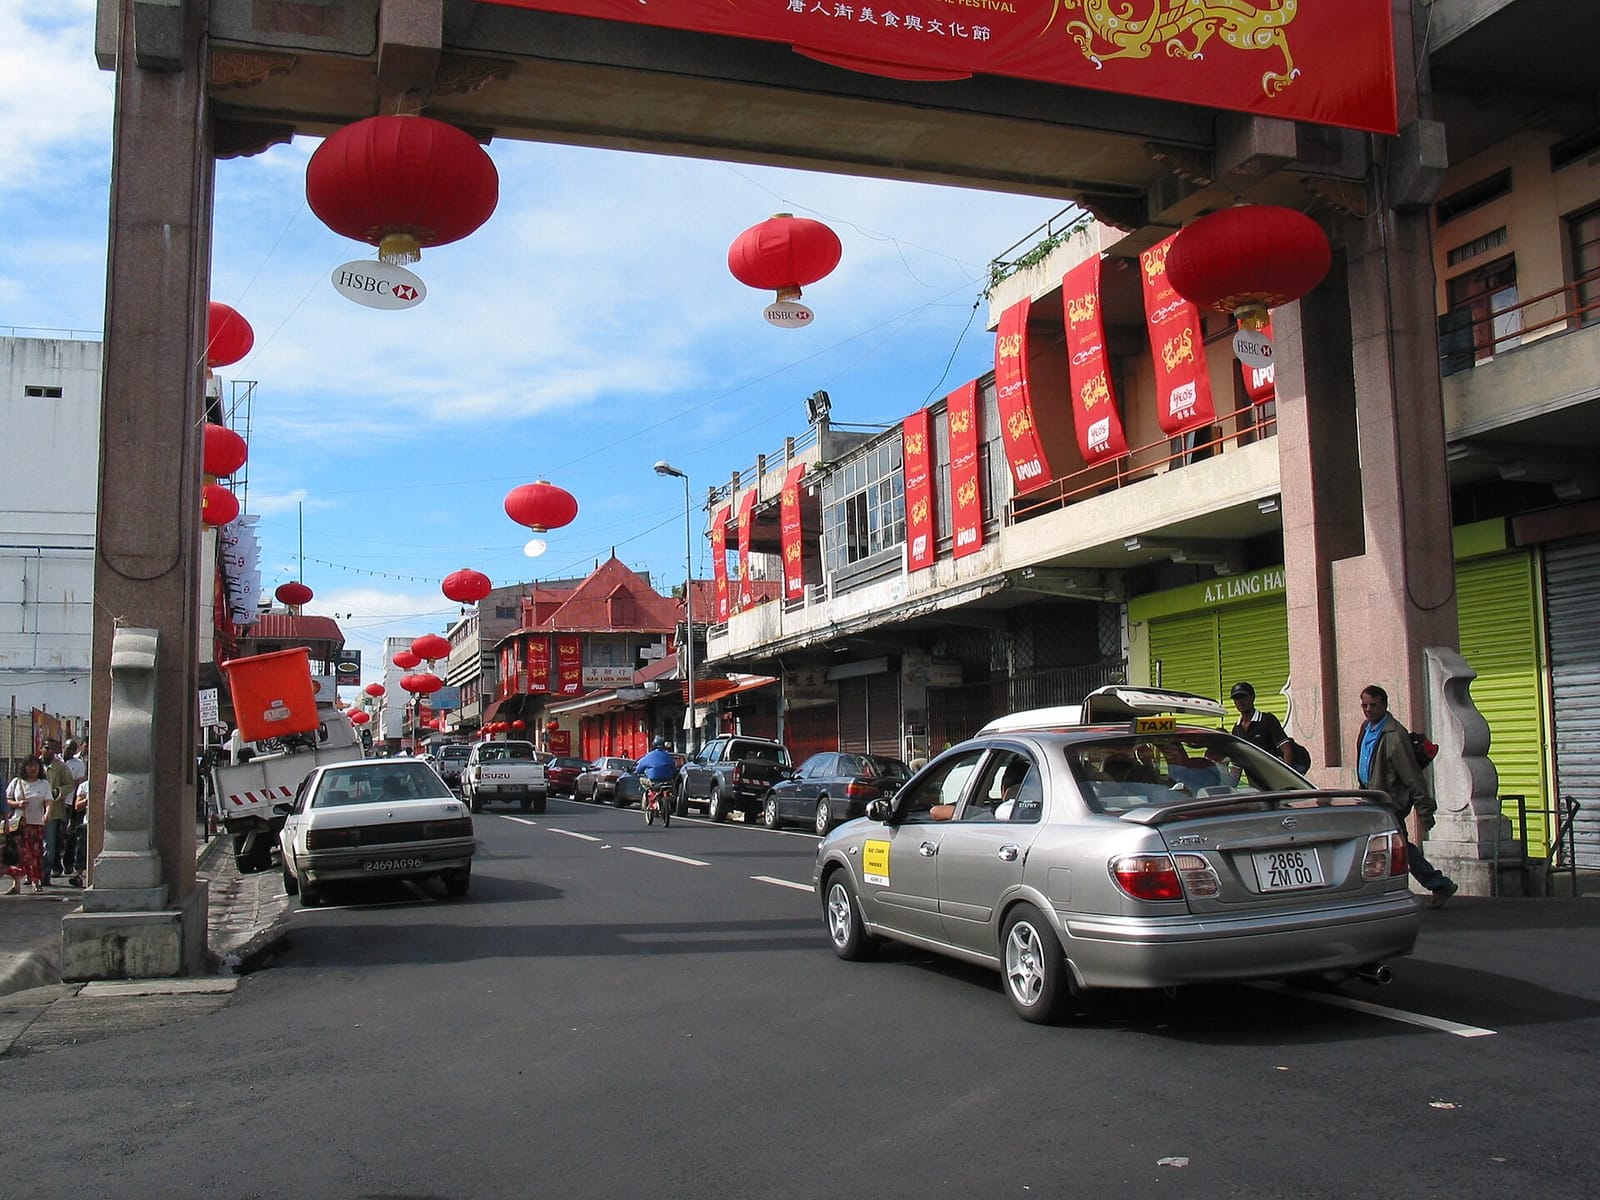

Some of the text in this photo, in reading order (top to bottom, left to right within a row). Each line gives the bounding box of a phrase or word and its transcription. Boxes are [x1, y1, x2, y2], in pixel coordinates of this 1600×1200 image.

[339, 271, 390, 295] HSBC
[767, 311, 795, 320] HSBC
[1237, 340, 1260, 355] HSBC
[1016, 459, 1042, 481] APOLLO
[1204, 583, 1225, 603] A.T.
[1227, 575, 1260, 598] LANG
[1139, 720, 1174, 731] TAXI
[481, 772, 511, 780] ISUZU
[1269, 852, 1304, 870] 2866
[1267, 867, 1313, 888] ZM 00
